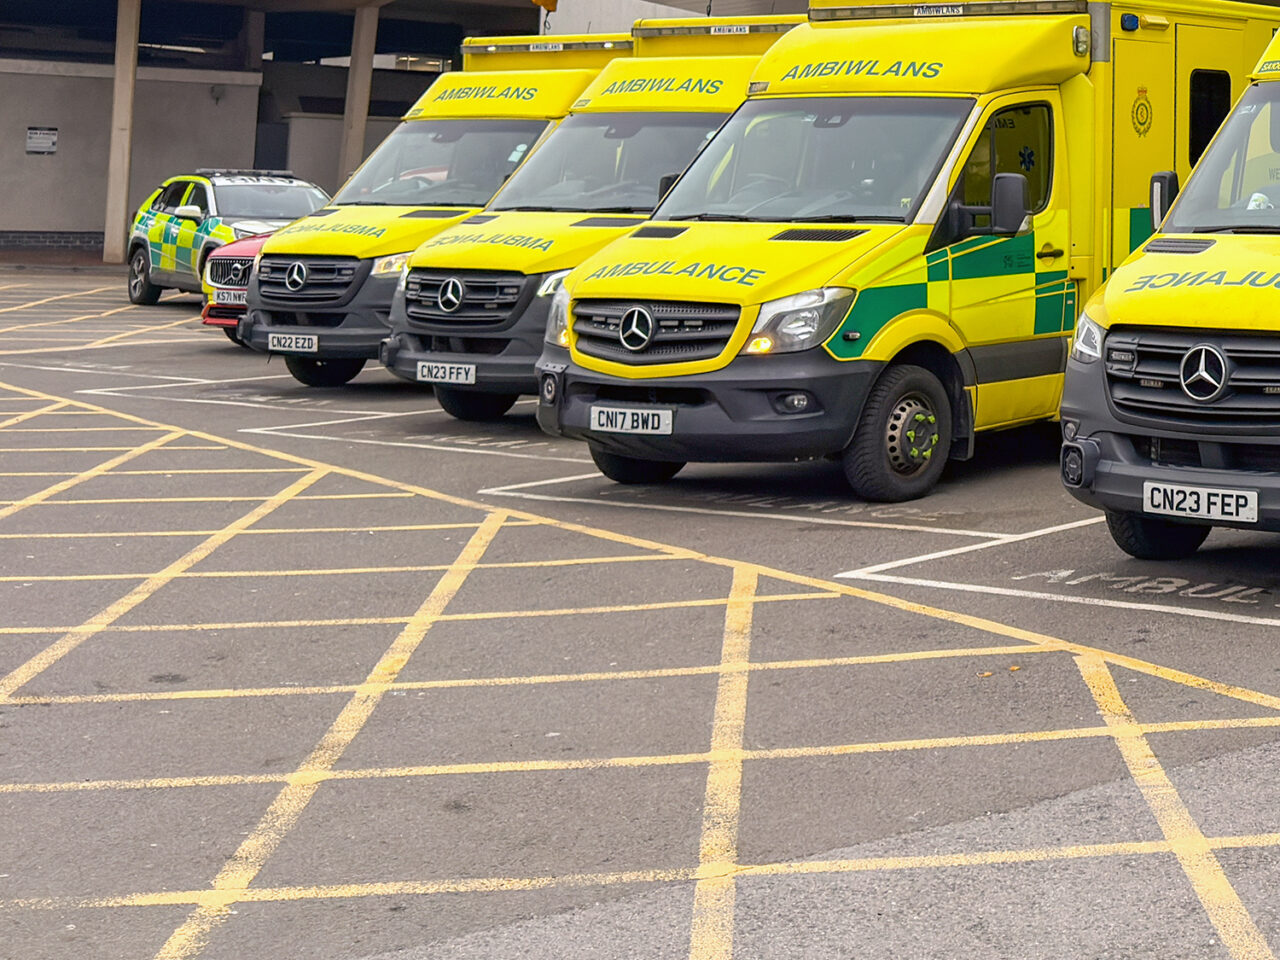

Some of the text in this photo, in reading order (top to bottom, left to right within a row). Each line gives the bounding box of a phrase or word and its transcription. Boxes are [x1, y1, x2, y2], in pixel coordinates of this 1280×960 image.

[916, 5, 961, 16] AMBIWLANS
[780, 60, 944, 81] AMBIWLANS
[434, 86, 538, 102] AMBIWLANS
[600, 78, 724, 95] AMBIWLANS
[584, 261, 766, 286] AMBULANCE
[271, 336, 314, 349] CN22 EZD
[421, 365, 471, 381] CN23 FFY
[598, 410, 661, 430] CN17 BWD
[1150, 487, 1249, 517] CN23 FEP
